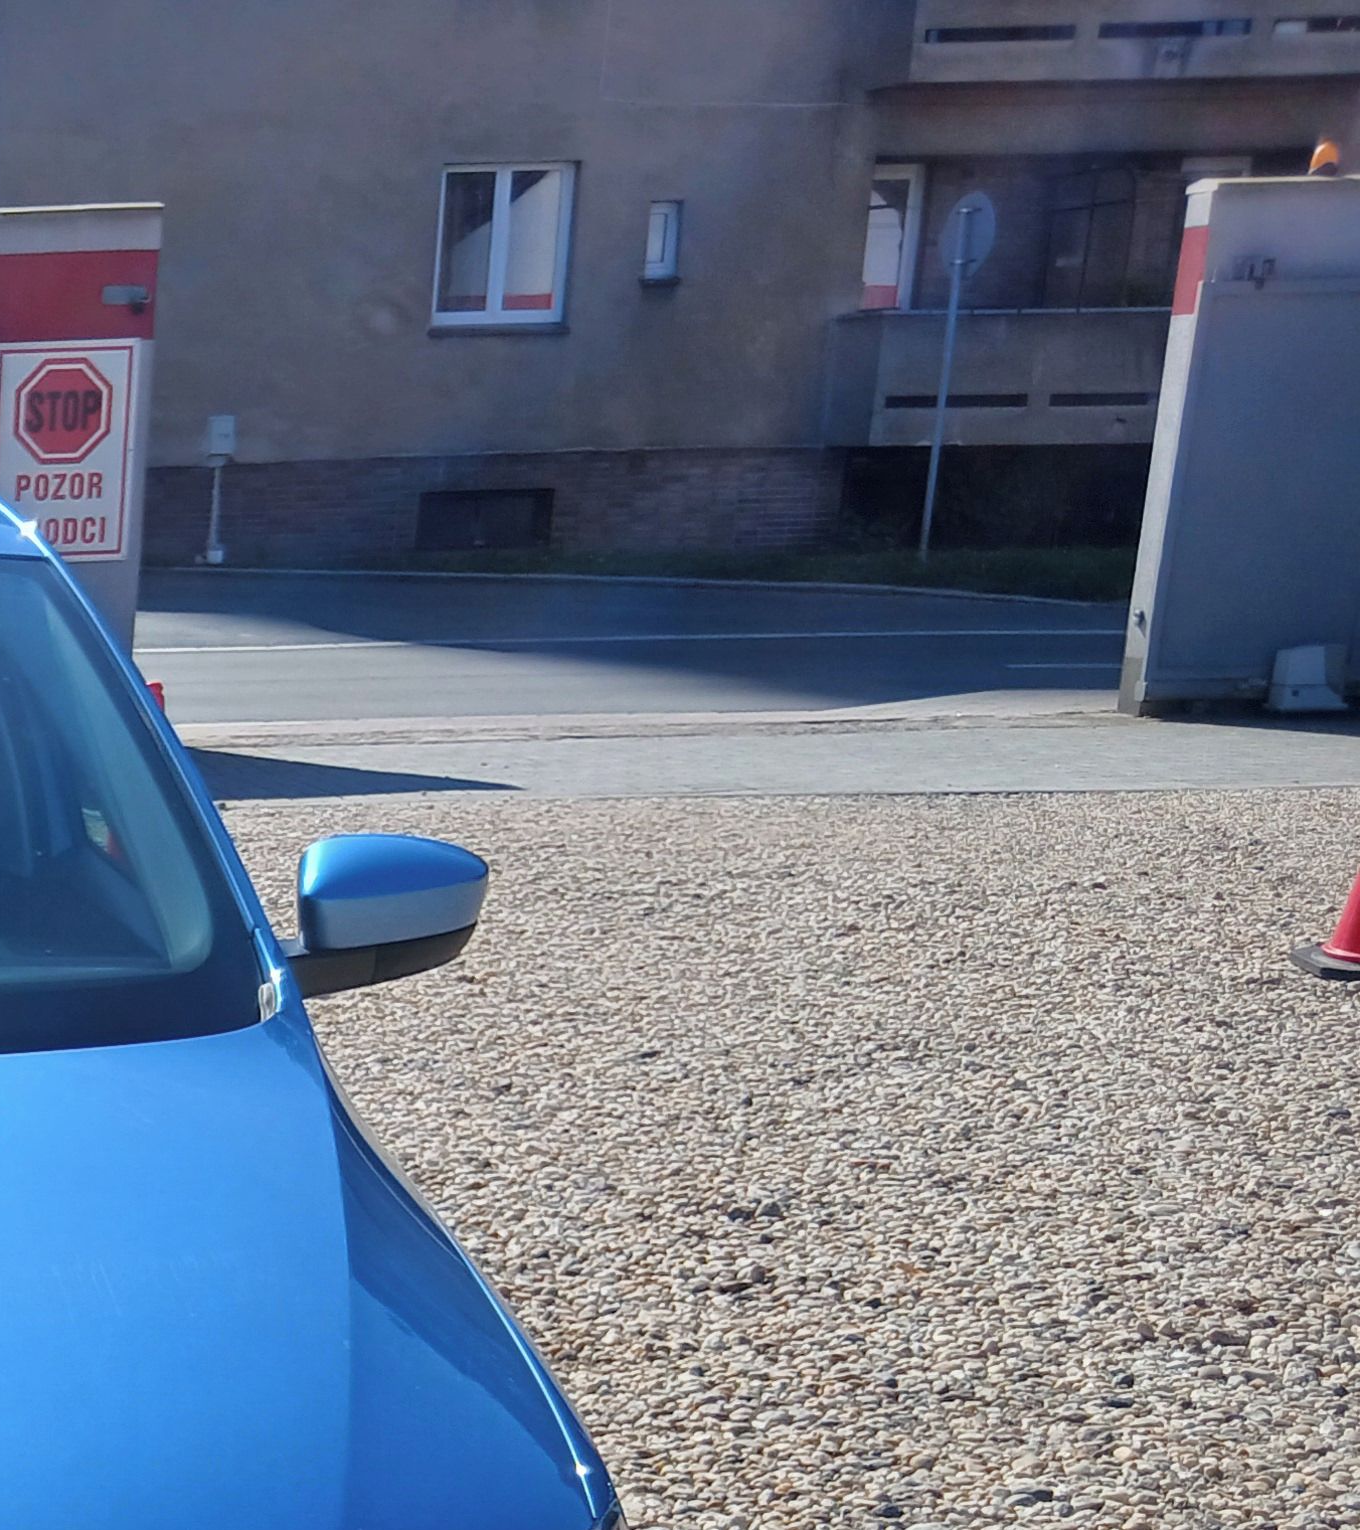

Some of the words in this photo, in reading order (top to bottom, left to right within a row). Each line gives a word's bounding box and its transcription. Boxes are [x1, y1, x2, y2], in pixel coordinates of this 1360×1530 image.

[26, 390, 103, 433] STOP
[15, 472, 103, 501] POZOR
[37, 516, 106, 545] ODCI
